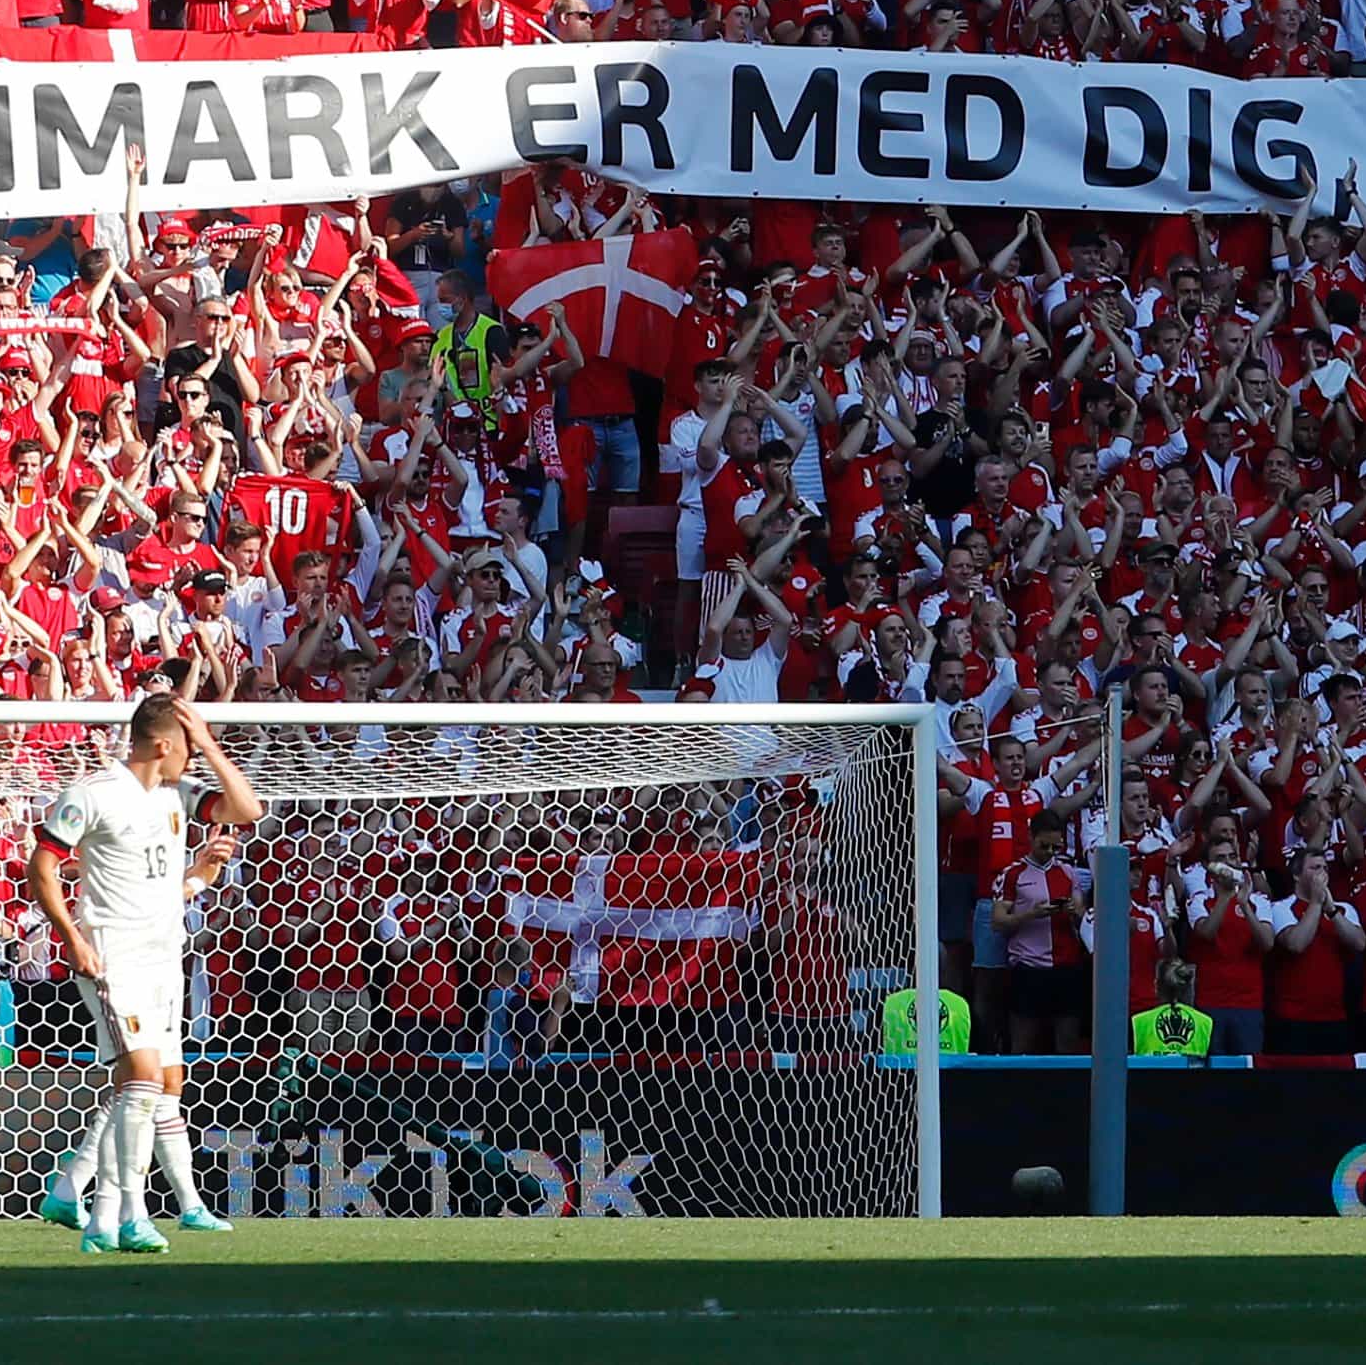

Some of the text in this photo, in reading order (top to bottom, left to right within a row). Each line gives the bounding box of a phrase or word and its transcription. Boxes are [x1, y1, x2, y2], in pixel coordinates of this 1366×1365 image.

[506, 62, 676, 171] ER
[730, 64, 1025, 181] MED
[263, 484, 307, 536] 10
[145, 845, 166, 880] 16
